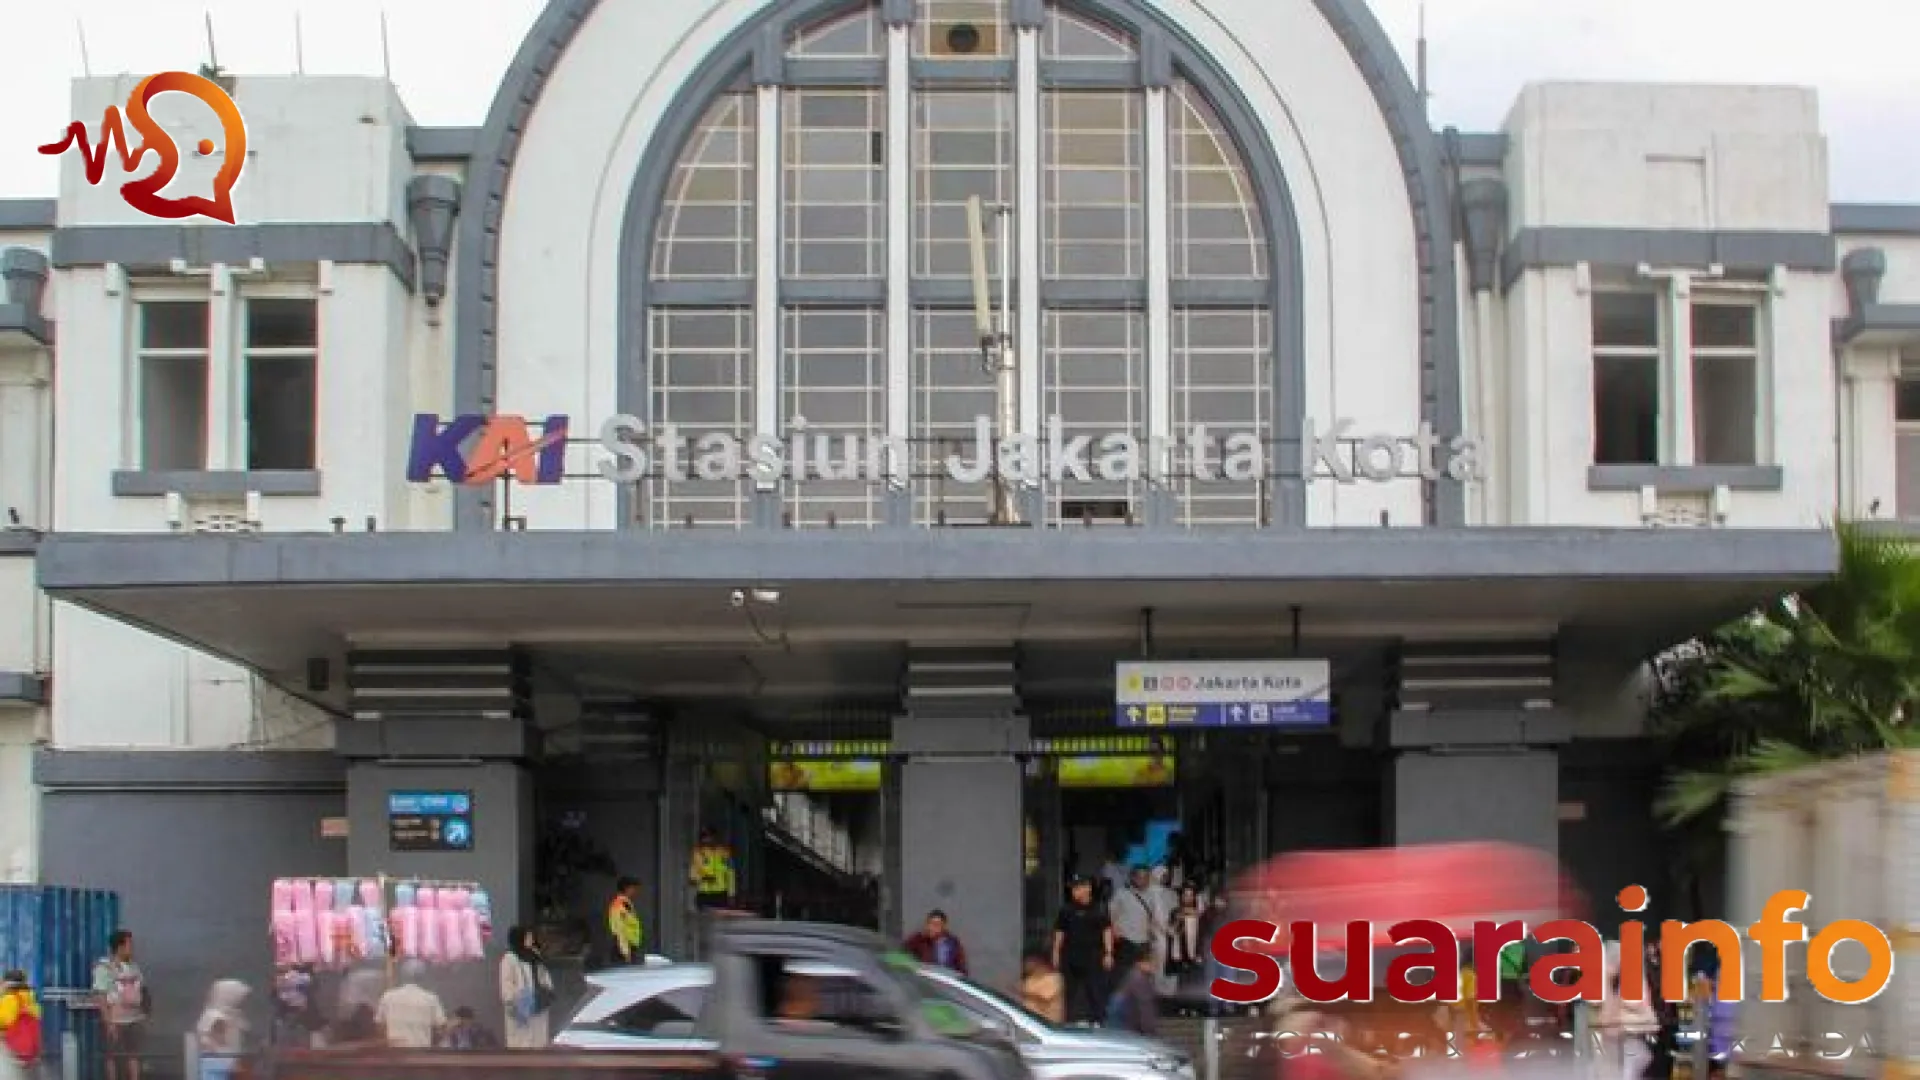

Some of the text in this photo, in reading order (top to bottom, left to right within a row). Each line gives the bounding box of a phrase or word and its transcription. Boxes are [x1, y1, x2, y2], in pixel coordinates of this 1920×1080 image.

[406, 413, 1490, 485] KAI Stasiun Jakarta Kota
